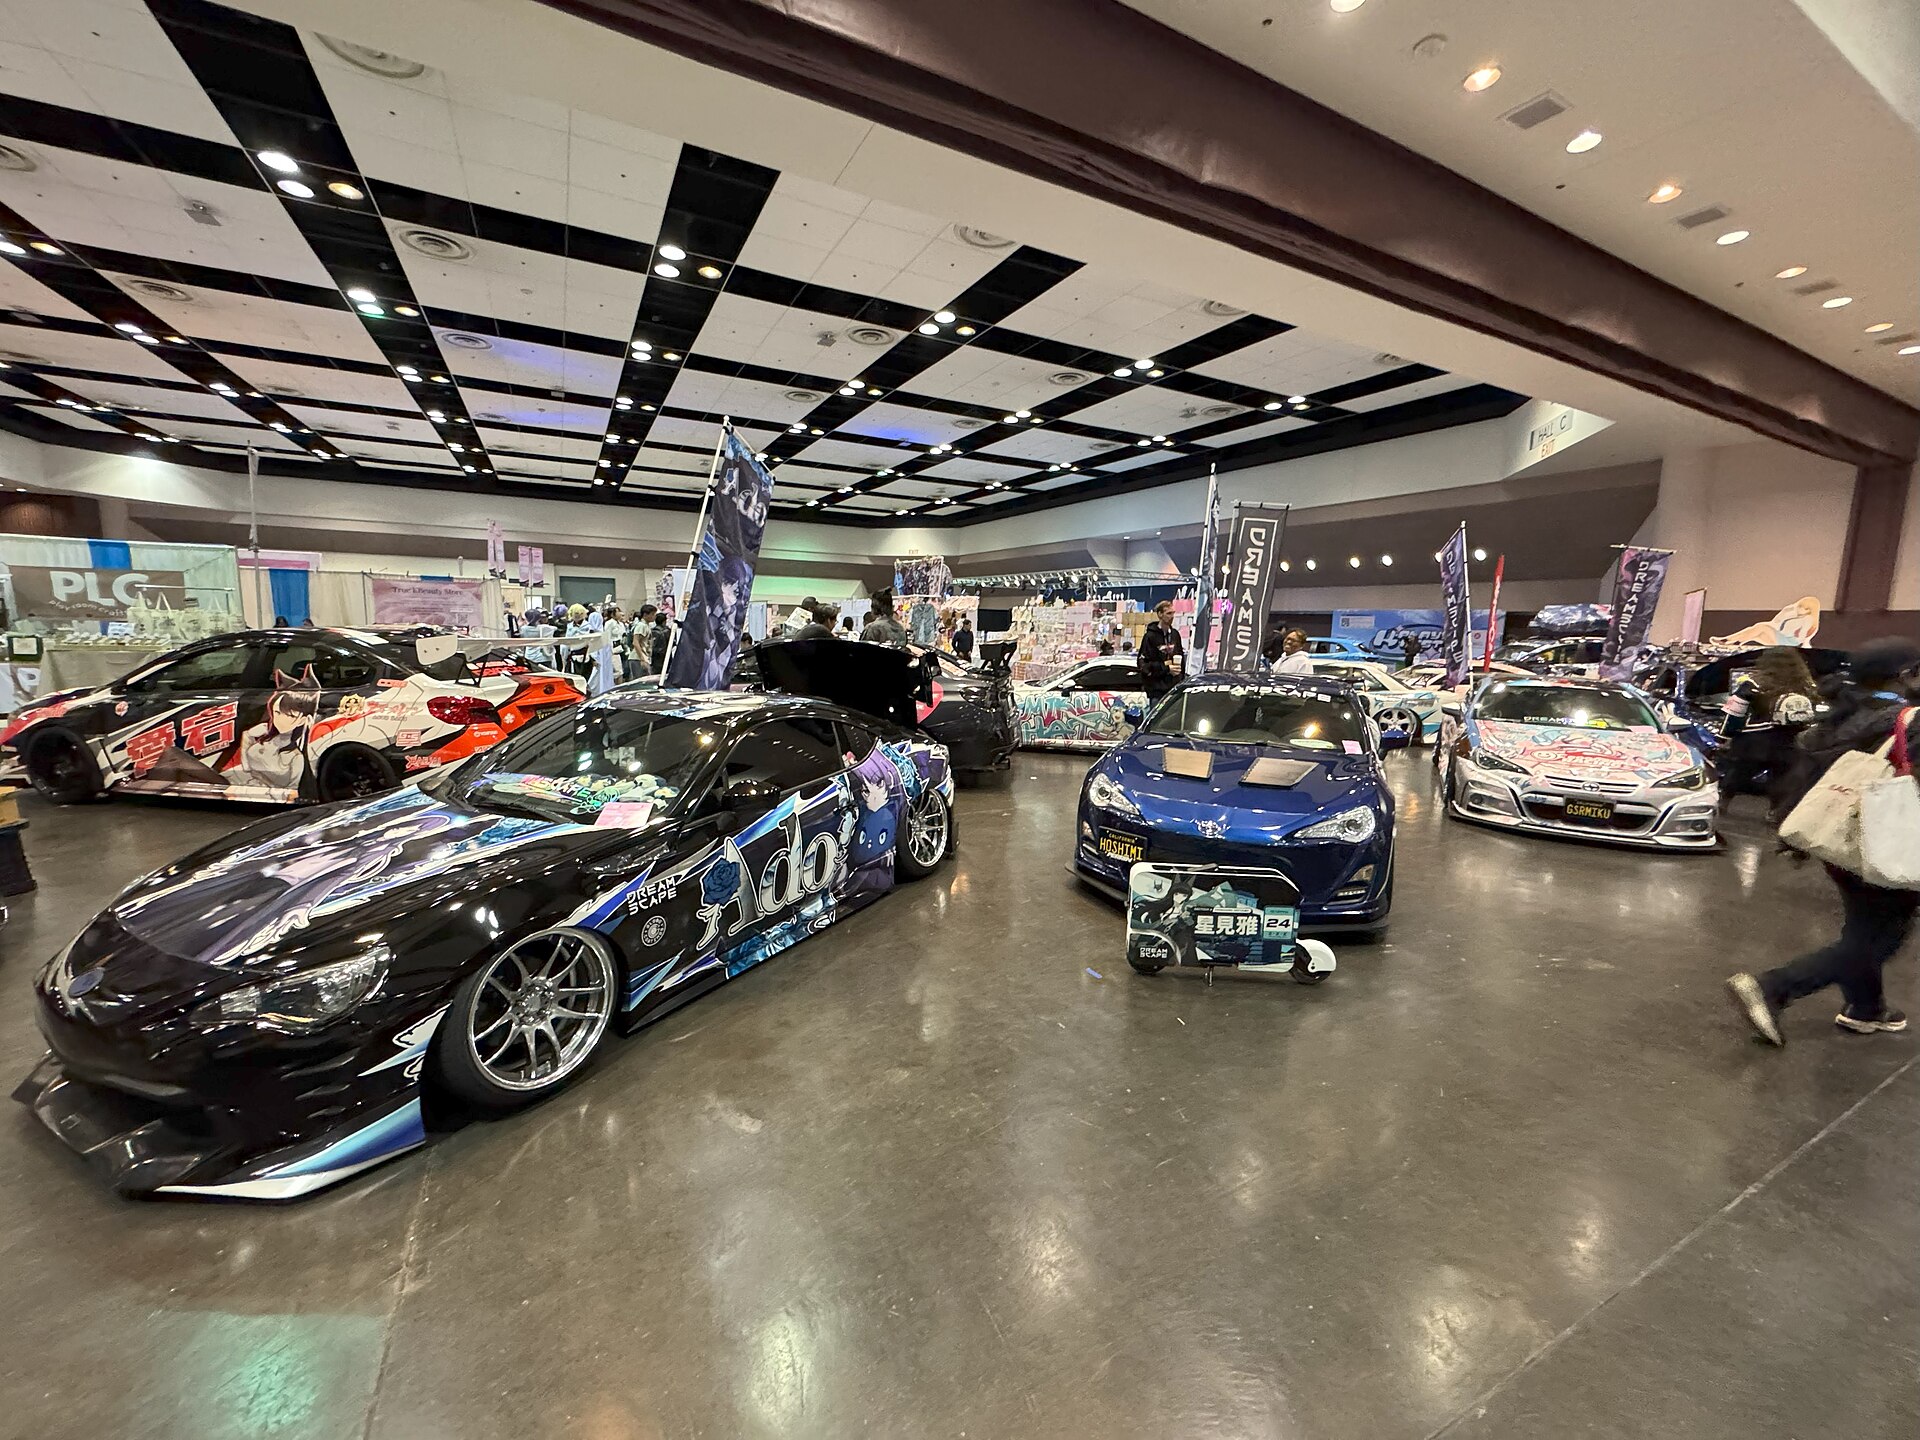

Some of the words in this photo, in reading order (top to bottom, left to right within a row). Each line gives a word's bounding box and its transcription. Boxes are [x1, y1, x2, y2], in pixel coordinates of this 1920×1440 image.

[1560, 415, 1567, 430] C
[721, 467, 767, 528] Ado
[49, 571, 149, 607] PLC
[1566, 804, 1611, 819] GSRMIKU
[1099, 837, 1143, 861] HOSHIMI
[626, 876, 676, 904] DREAM
[695, 812, 839, 950] Ado
[628, 887, 677, 915] SCAPE
[1194, 915, 1258, 936] 星見雅
[1266, 918, 1291, 929] 24
